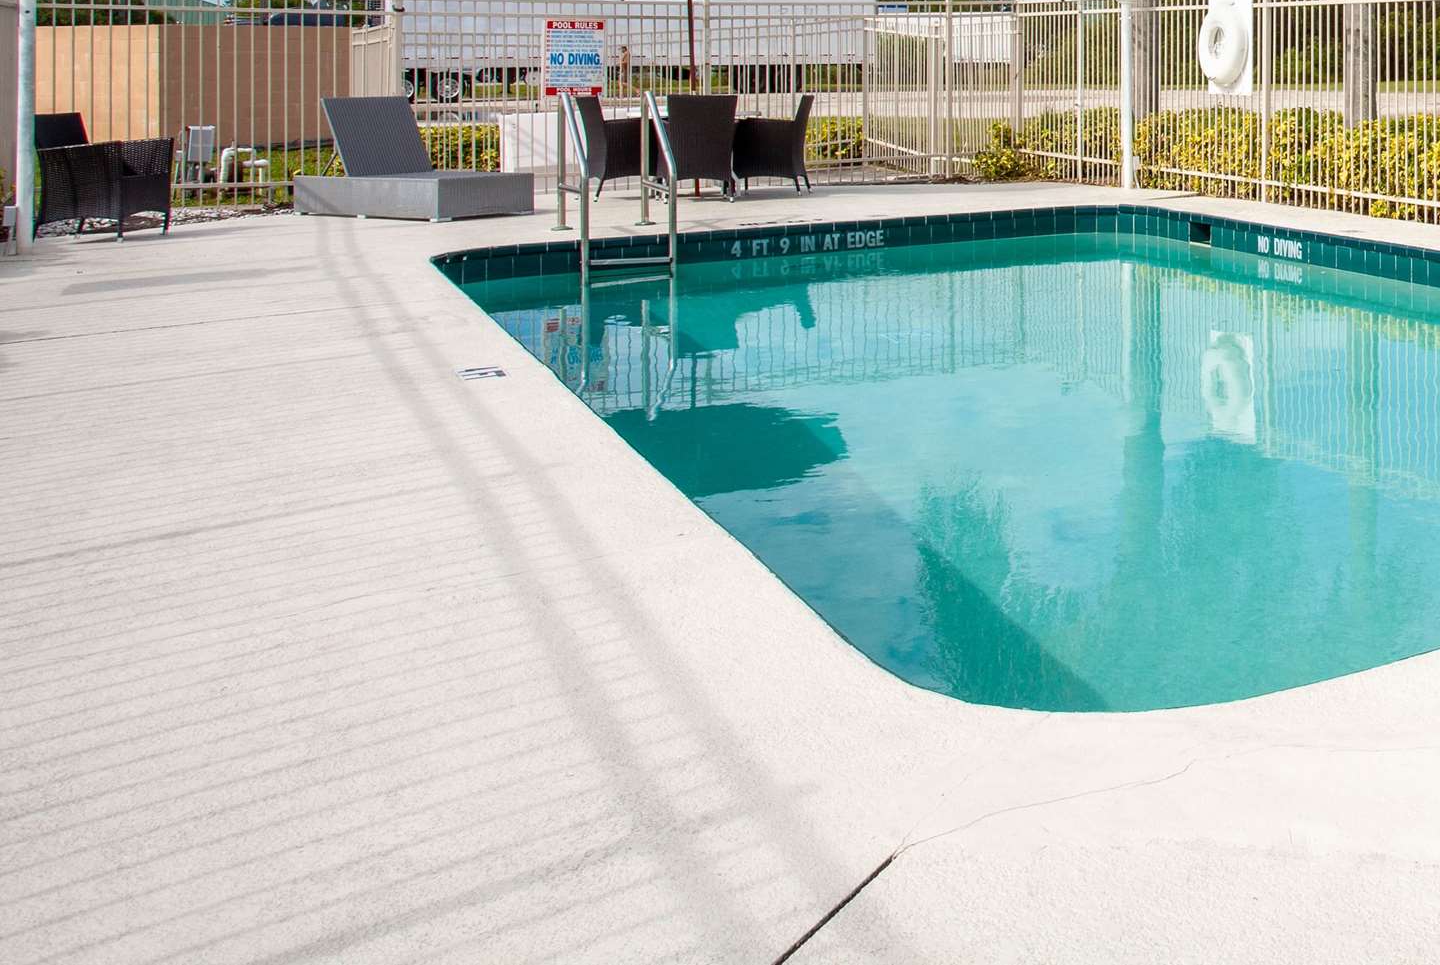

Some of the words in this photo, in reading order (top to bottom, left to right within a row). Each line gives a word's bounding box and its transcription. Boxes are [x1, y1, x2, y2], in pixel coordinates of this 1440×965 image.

[552, 21, 573, 29] POOL
[575, 21, 599, 29] RULES
[550, 52, 565, 65] NO
[731, 240, 742, 257] 4
[752, 239, 769, 256] FT
[780, 238, 790, 254] 9
[800, 235, 816, 253] IN
[823, 233, 840, 251] AT
[847, 229, 884, 249] EDGE
[1258, 236, 1269, 253] NO
[1274, 238, 1302, 259] DIVING
